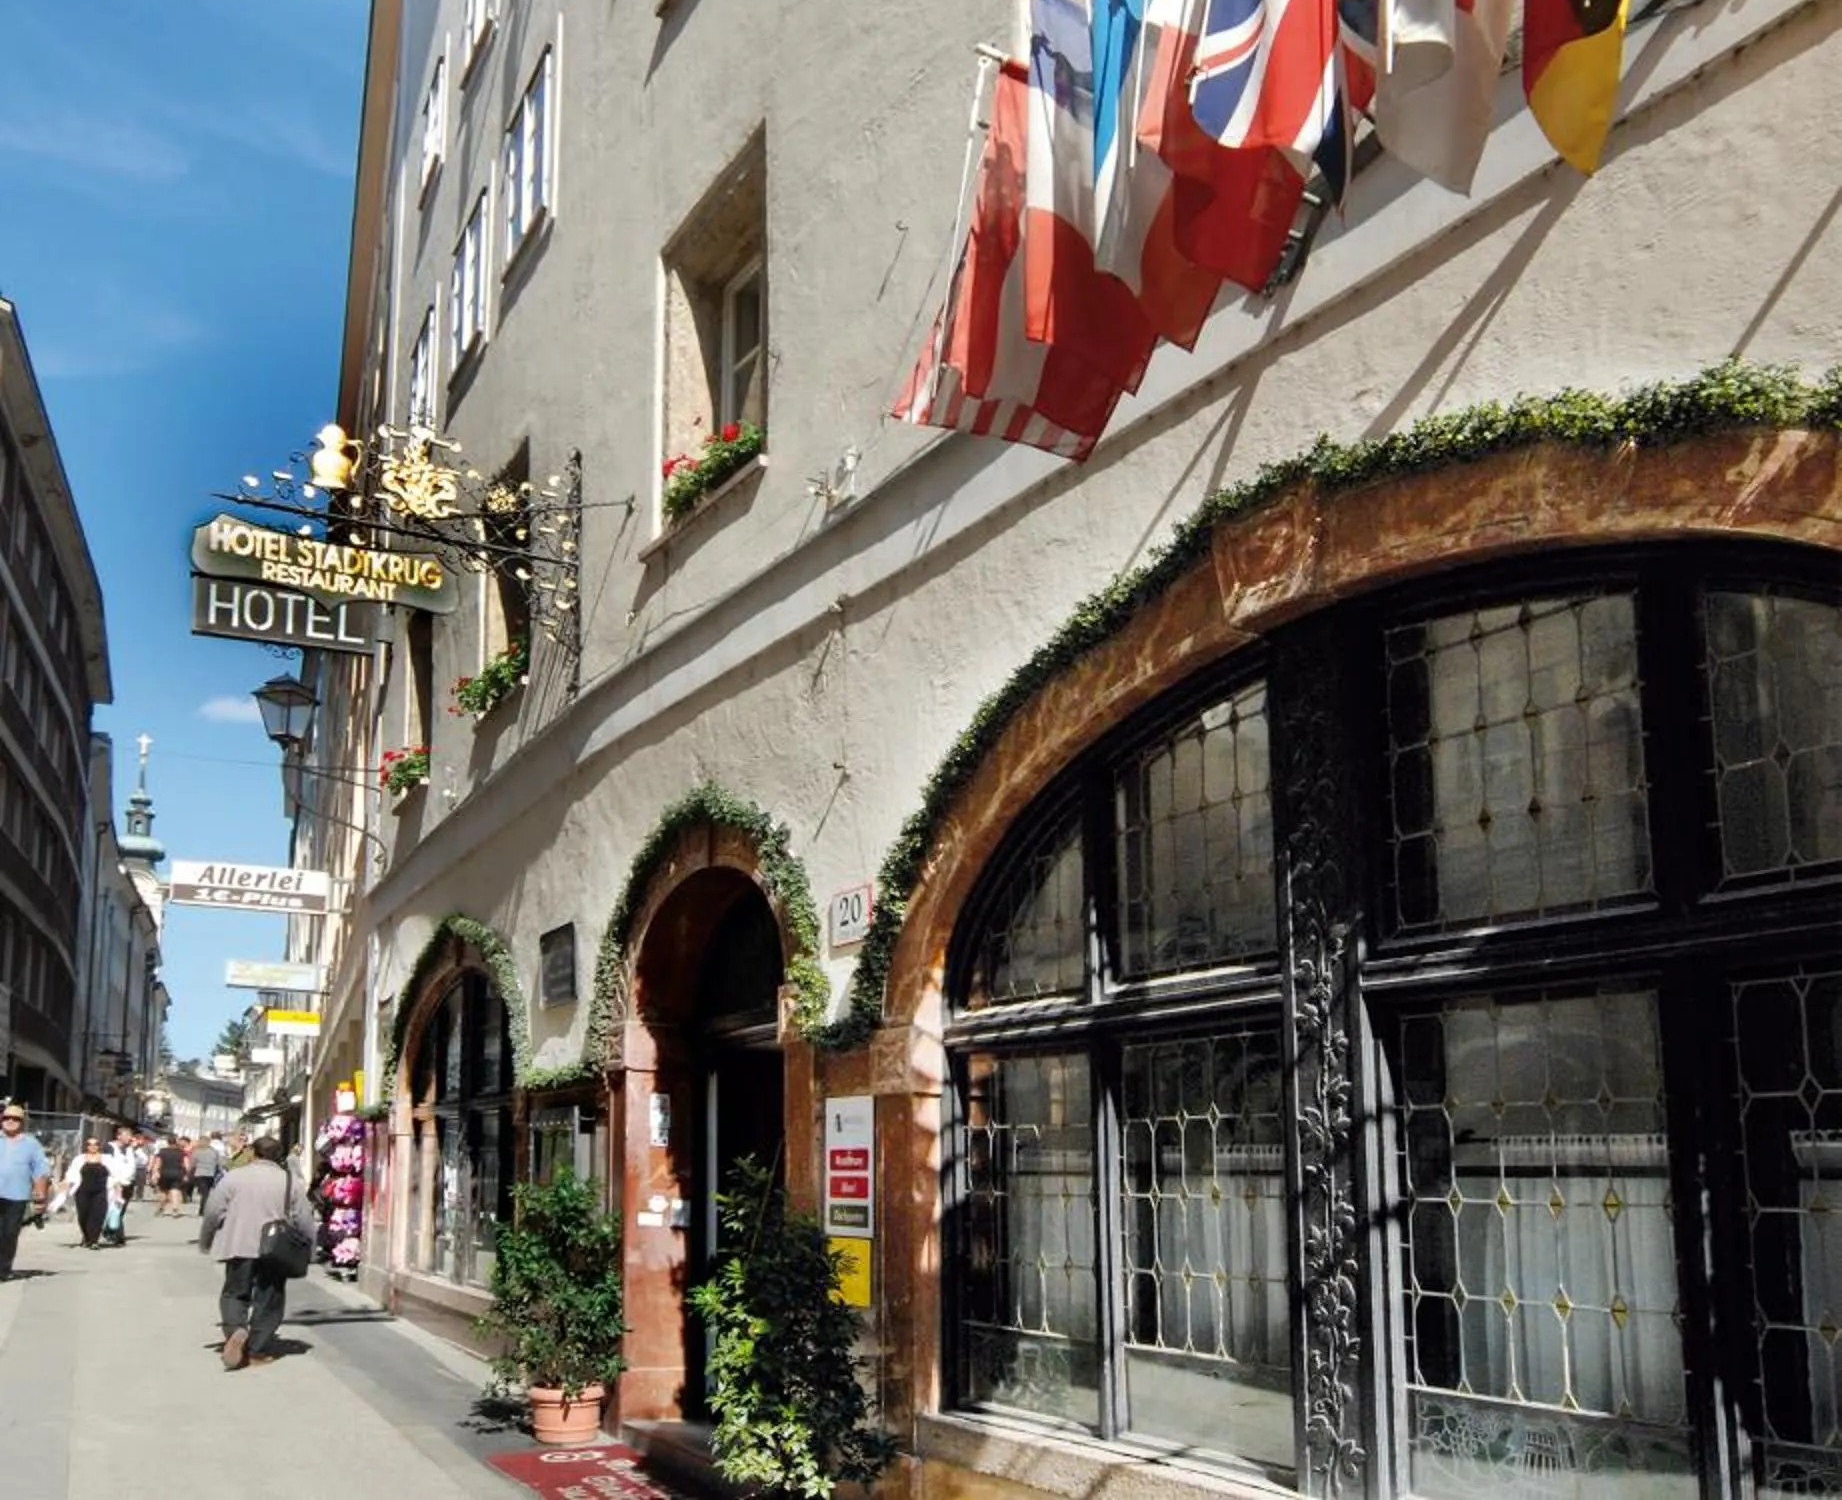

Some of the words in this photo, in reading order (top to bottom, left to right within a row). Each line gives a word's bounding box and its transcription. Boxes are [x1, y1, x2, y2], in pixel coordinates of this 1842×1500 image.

[209, 520, 291, 562] HOTEL
[297, 539, 442, 589] STADTKRUG
[261, 560, 397, 600] RESTAURANT
[208, 583, 365, 645] HOTEL
[198, 864, 304, 891] Allerlei
[839, 893, 862, 927] 20
